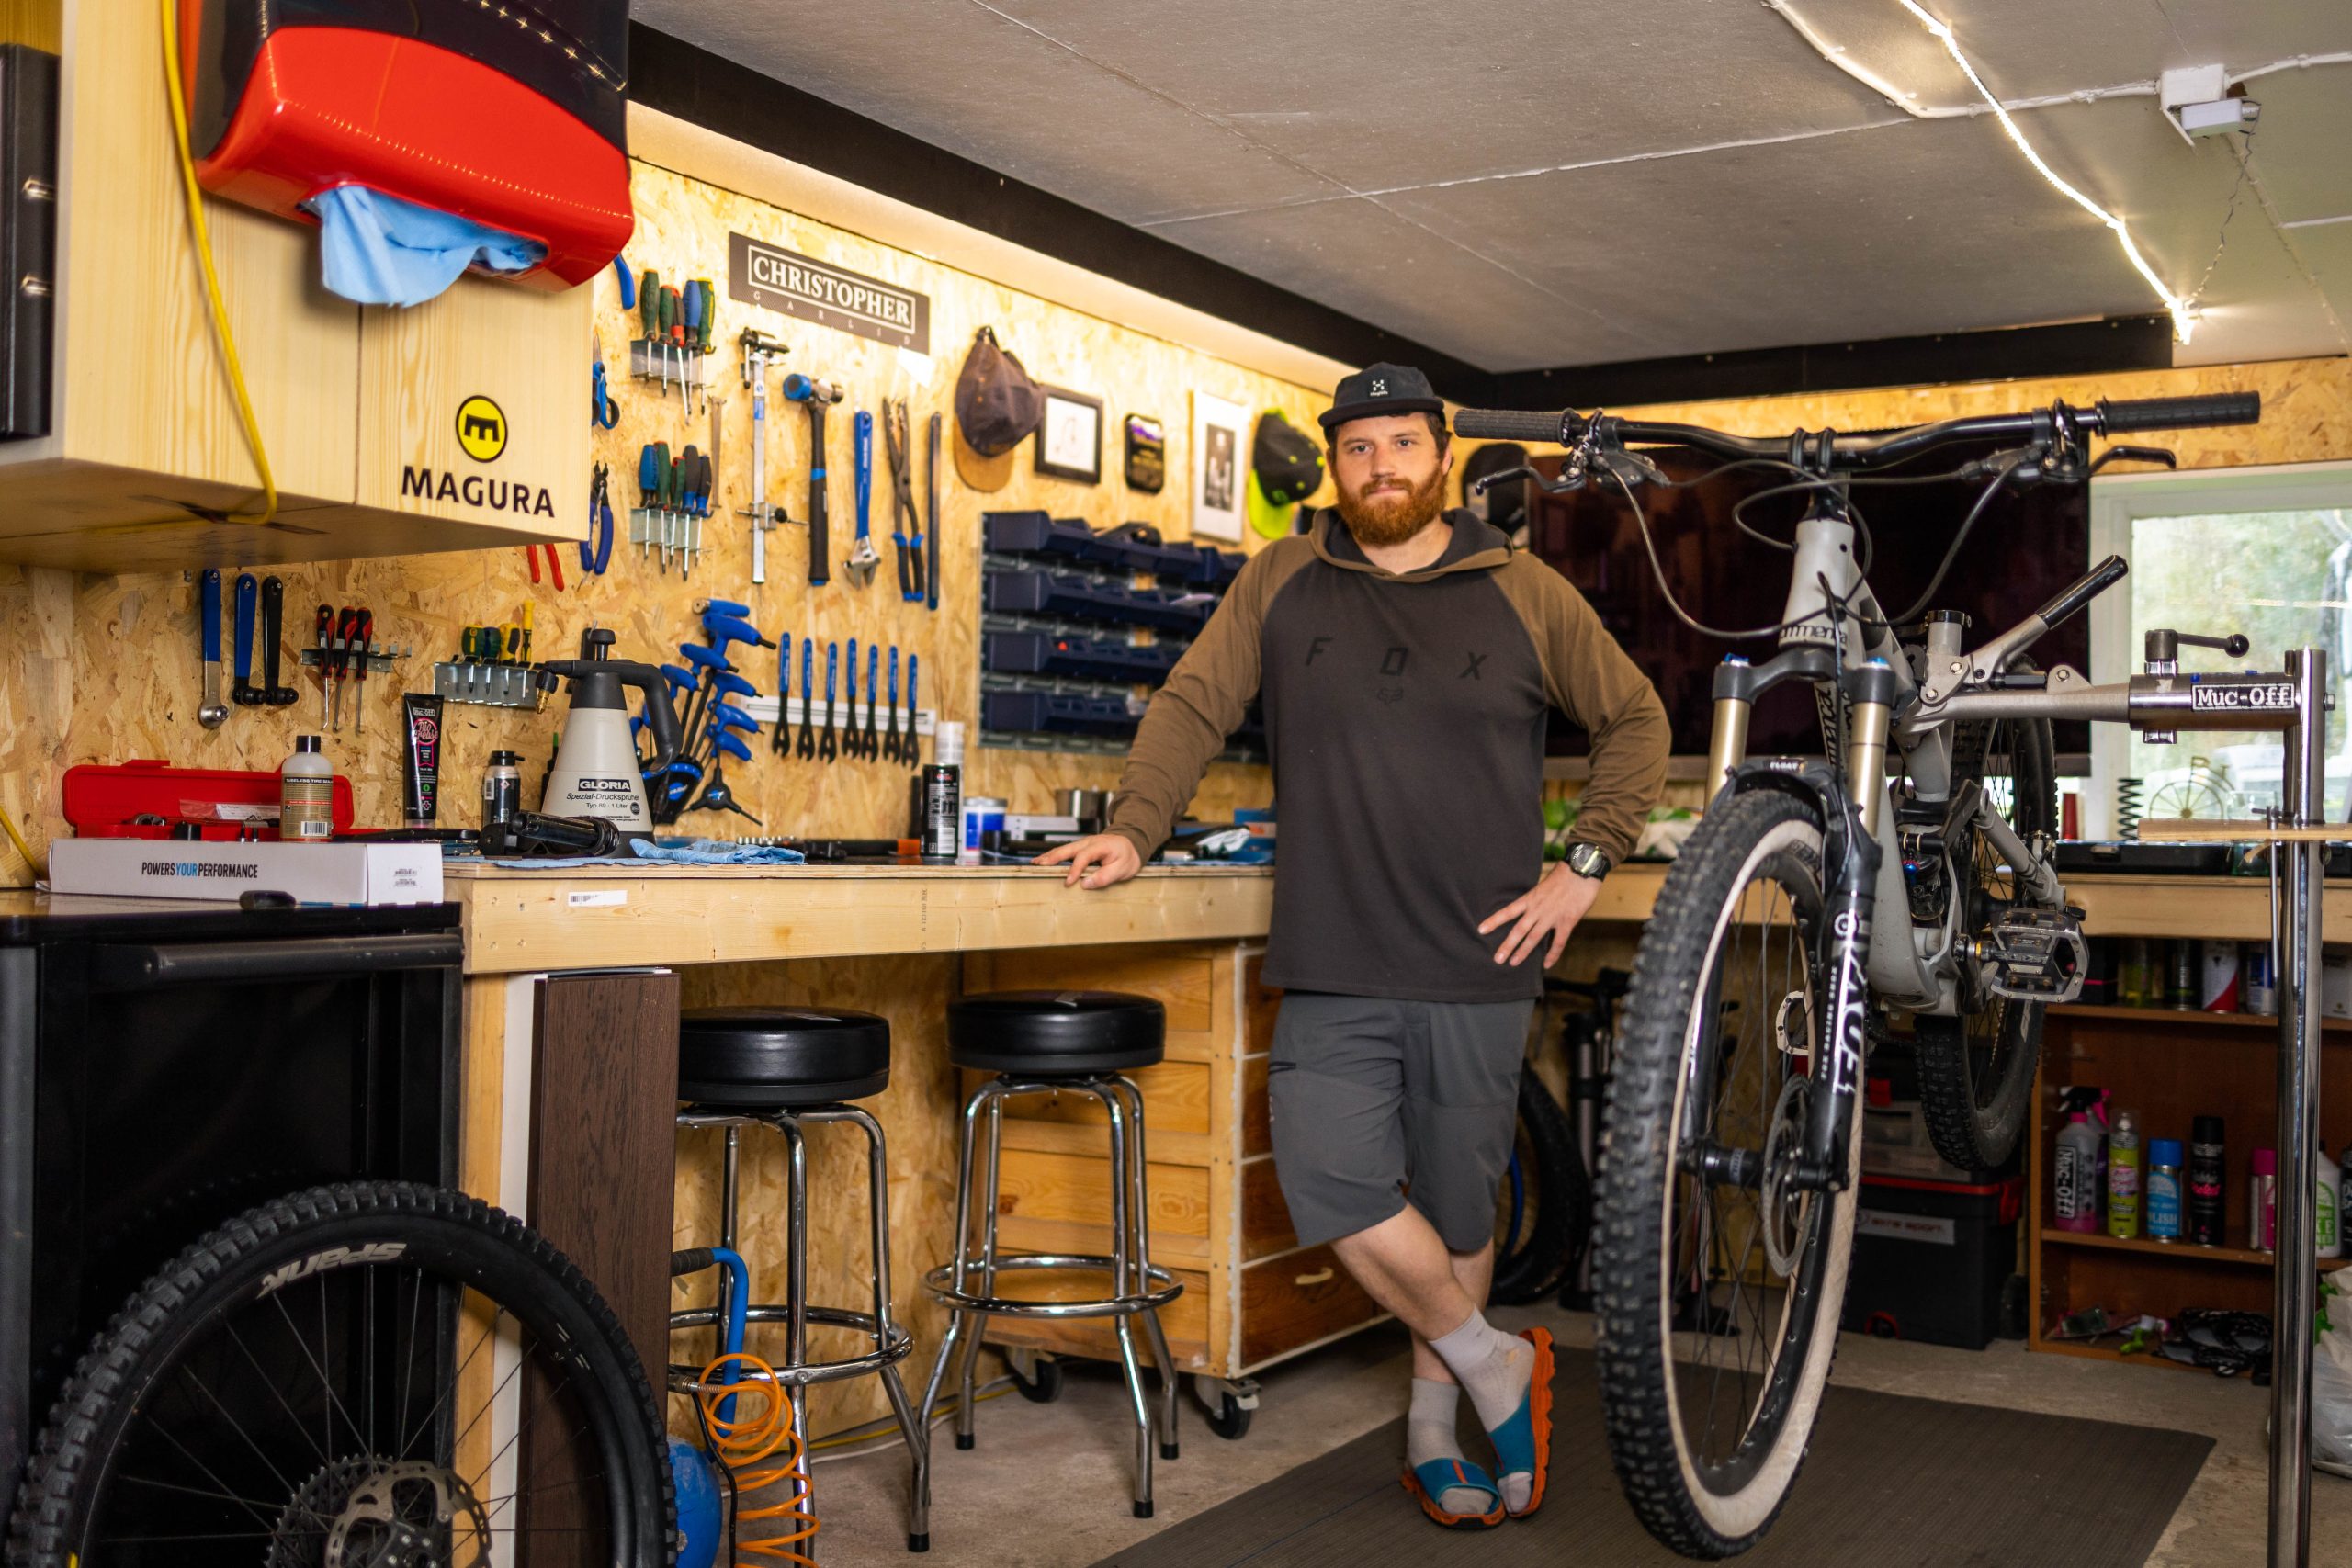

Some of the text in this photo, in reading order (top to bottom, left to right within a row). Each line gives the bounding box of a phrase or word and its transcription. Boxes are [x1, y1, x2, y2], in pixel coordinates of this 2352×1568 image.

[752, 255, 910, 326] CHRISTOPHER
[401, 464, 556, 519] MAGURA
[2197, 686, 2290, 706] Muc-Off
[579, 780, 630, 790] GLORIA
[566, 792, 639, 802] Spezial-Drucksprüher
